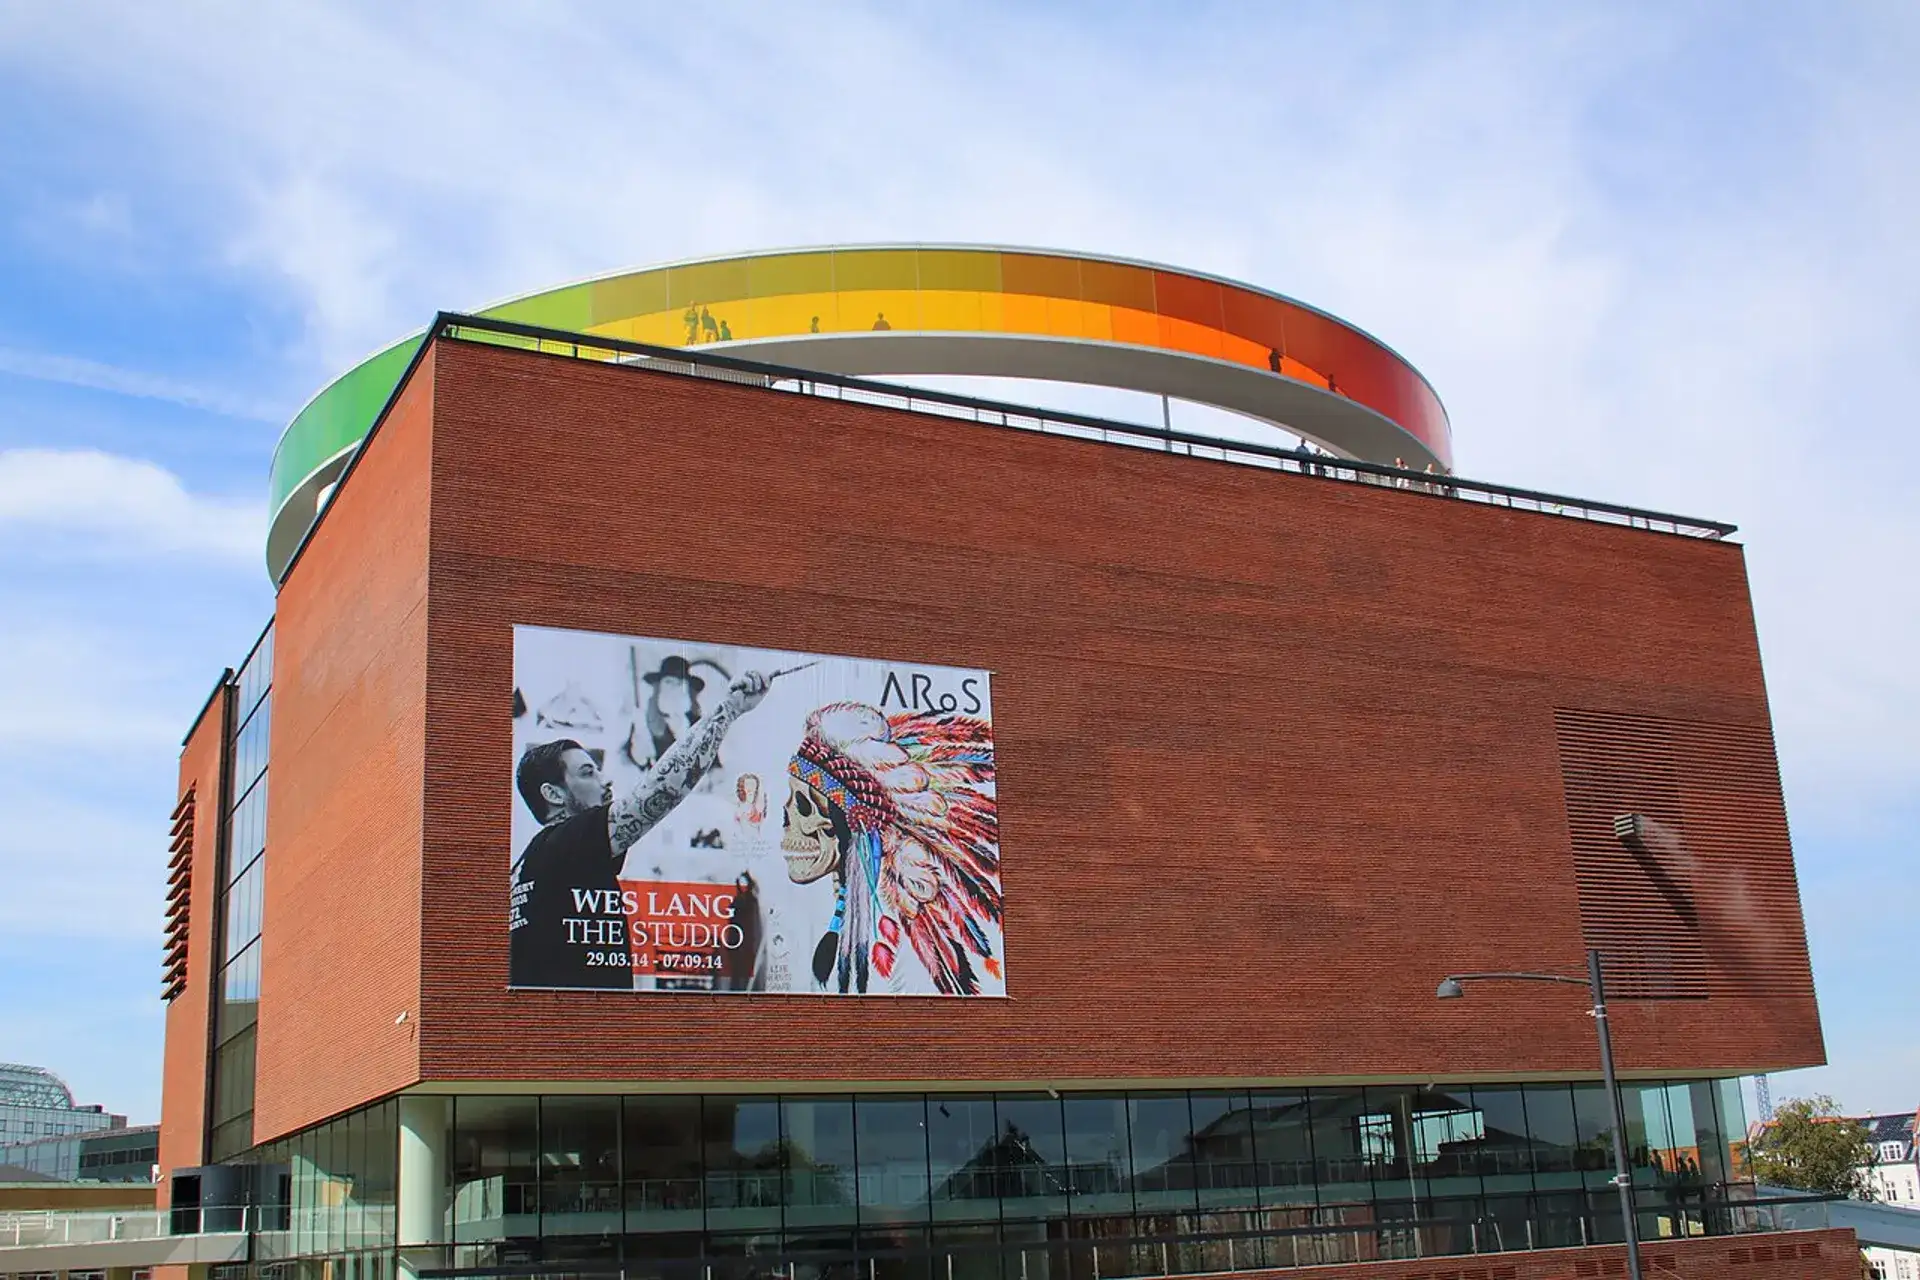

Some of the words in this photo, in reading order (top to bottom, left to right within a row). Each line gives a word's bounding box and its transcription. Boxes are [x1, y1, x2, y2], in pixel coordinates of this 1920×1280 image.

[571, 888, 639, 916] WES
[647, 891, 736, 919] LANG
[562, 917, 625, 945] THE
[632, 921, 745, 949] STUDIO
[586, 951, 649, 967] 29.03.14
[663, 953, 723, 969] 07.09.14
